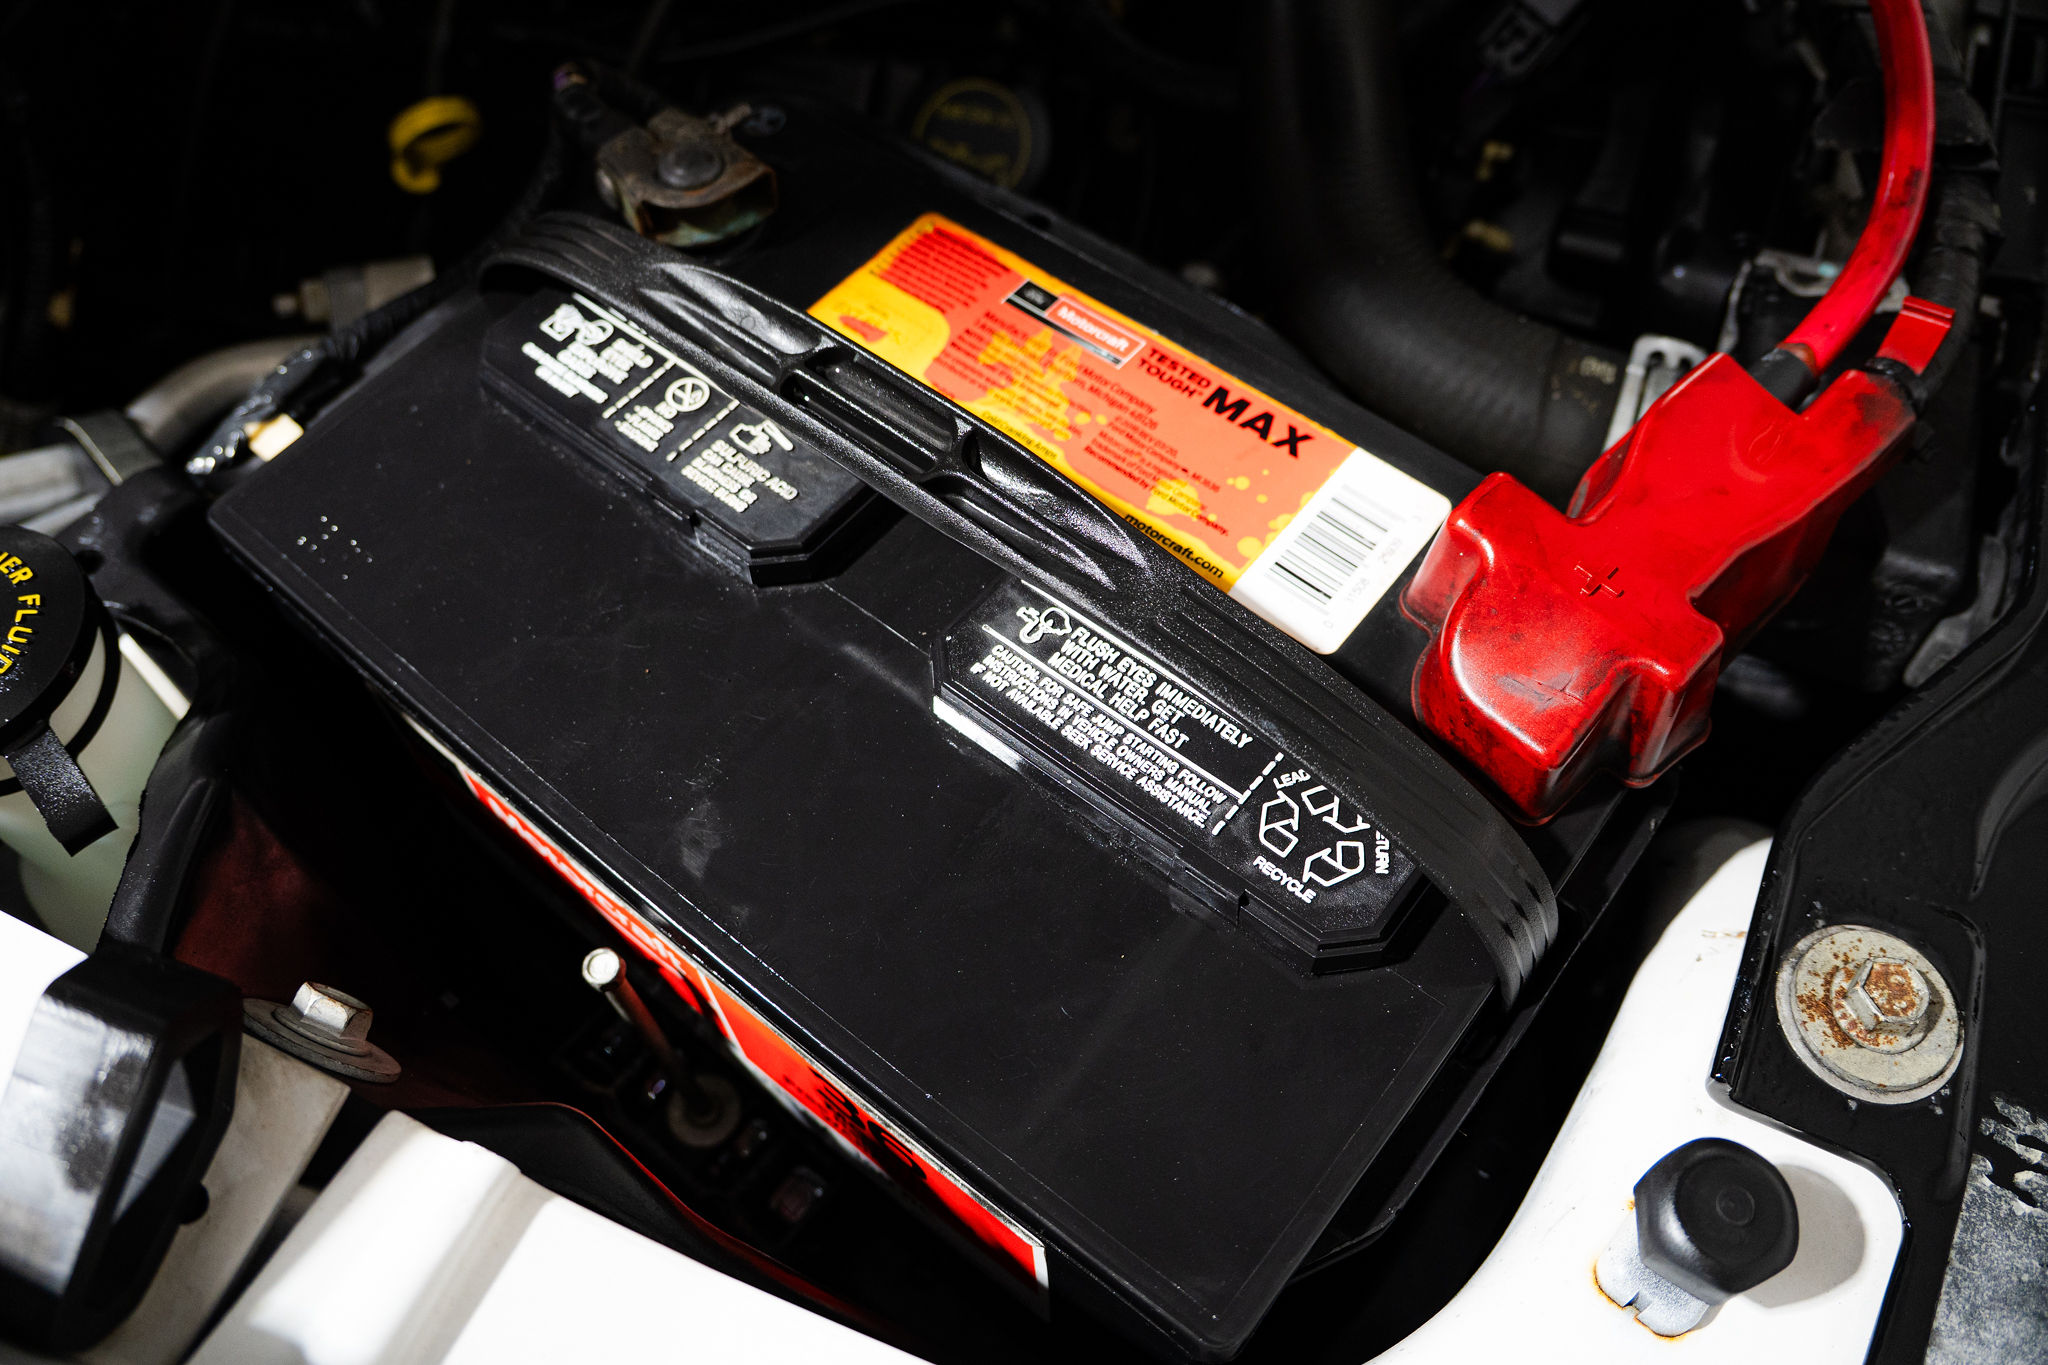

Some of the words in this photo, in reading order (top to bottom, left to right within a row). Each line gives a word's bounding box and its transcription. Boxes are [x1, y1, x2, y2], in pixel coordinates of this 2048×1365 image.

[1055, 304, 1131, 353] Motorcraft
[1081, 366, 1112, 388] Motor
[1107, 381, 1158, 416] Company
[1085, 383, 1132, 415] Michigan
[1147, 347, 1212, 389] TESTED
[1202, 382, 1313, 459] MAX
[700, 449, 724, 467] CAN
[710, 440, 770, 482] SULFURIC
[762, 474, 798, 500] ACID
[1083, 444, 1141, 482] Recommended
[1167, 495, 1191, 512] Motor
[1122, 512, 1226, 578] motorcraft.com
[1048, 652, 1108, 699] MEDICAL
[1109, 692, 1150, 721] HELP
[1148, 718, 1189, 748] FAST
[1061, 639, 1100, 670] WITH
[1099, 664, 1148, 705] WATER.
[1152, 699, 1185, 724] GET
[1071, 627, 1120, 663] FLUSH
[1117, 657, 1157, 687] EYES
[1155, 682, 1253, 748] IMMEDIATELY
[970, 663, 986, 674] IF
[982, 670, 1010, 691] NOT
[1006, 688, 1064, 730] AVAILABLE
[1061, 725, 1093, 750] SEEK
[1090, 744, 1139, 780] SERVICE
[1136, 776, 1207, 828] ASSISTANCE.
[982, 655, 1059, 710] INSTRUCTIONS
[1057, 705, 1073, 720] IN
[1072, 715, 1118, 750] VEHICLE
[1116, 744, 1165, 781] OWNERS
[1164, 777, 1211, 815] MANUAL.
[991, 645, 1040, 682] CAUTION:
[1038, 677, 1065, 698] FOR
[1062, 693, 1094, 717] SAFE
[1091, 714, 1125, 735] JUMP
[1123, 733, 1179, 774] STARTING
[1178, 769, 1227, 803] FOLLOW
[1273, 768, 1311, 789] LEAD
[1253, 855, 1317, 904] RECYCLE
